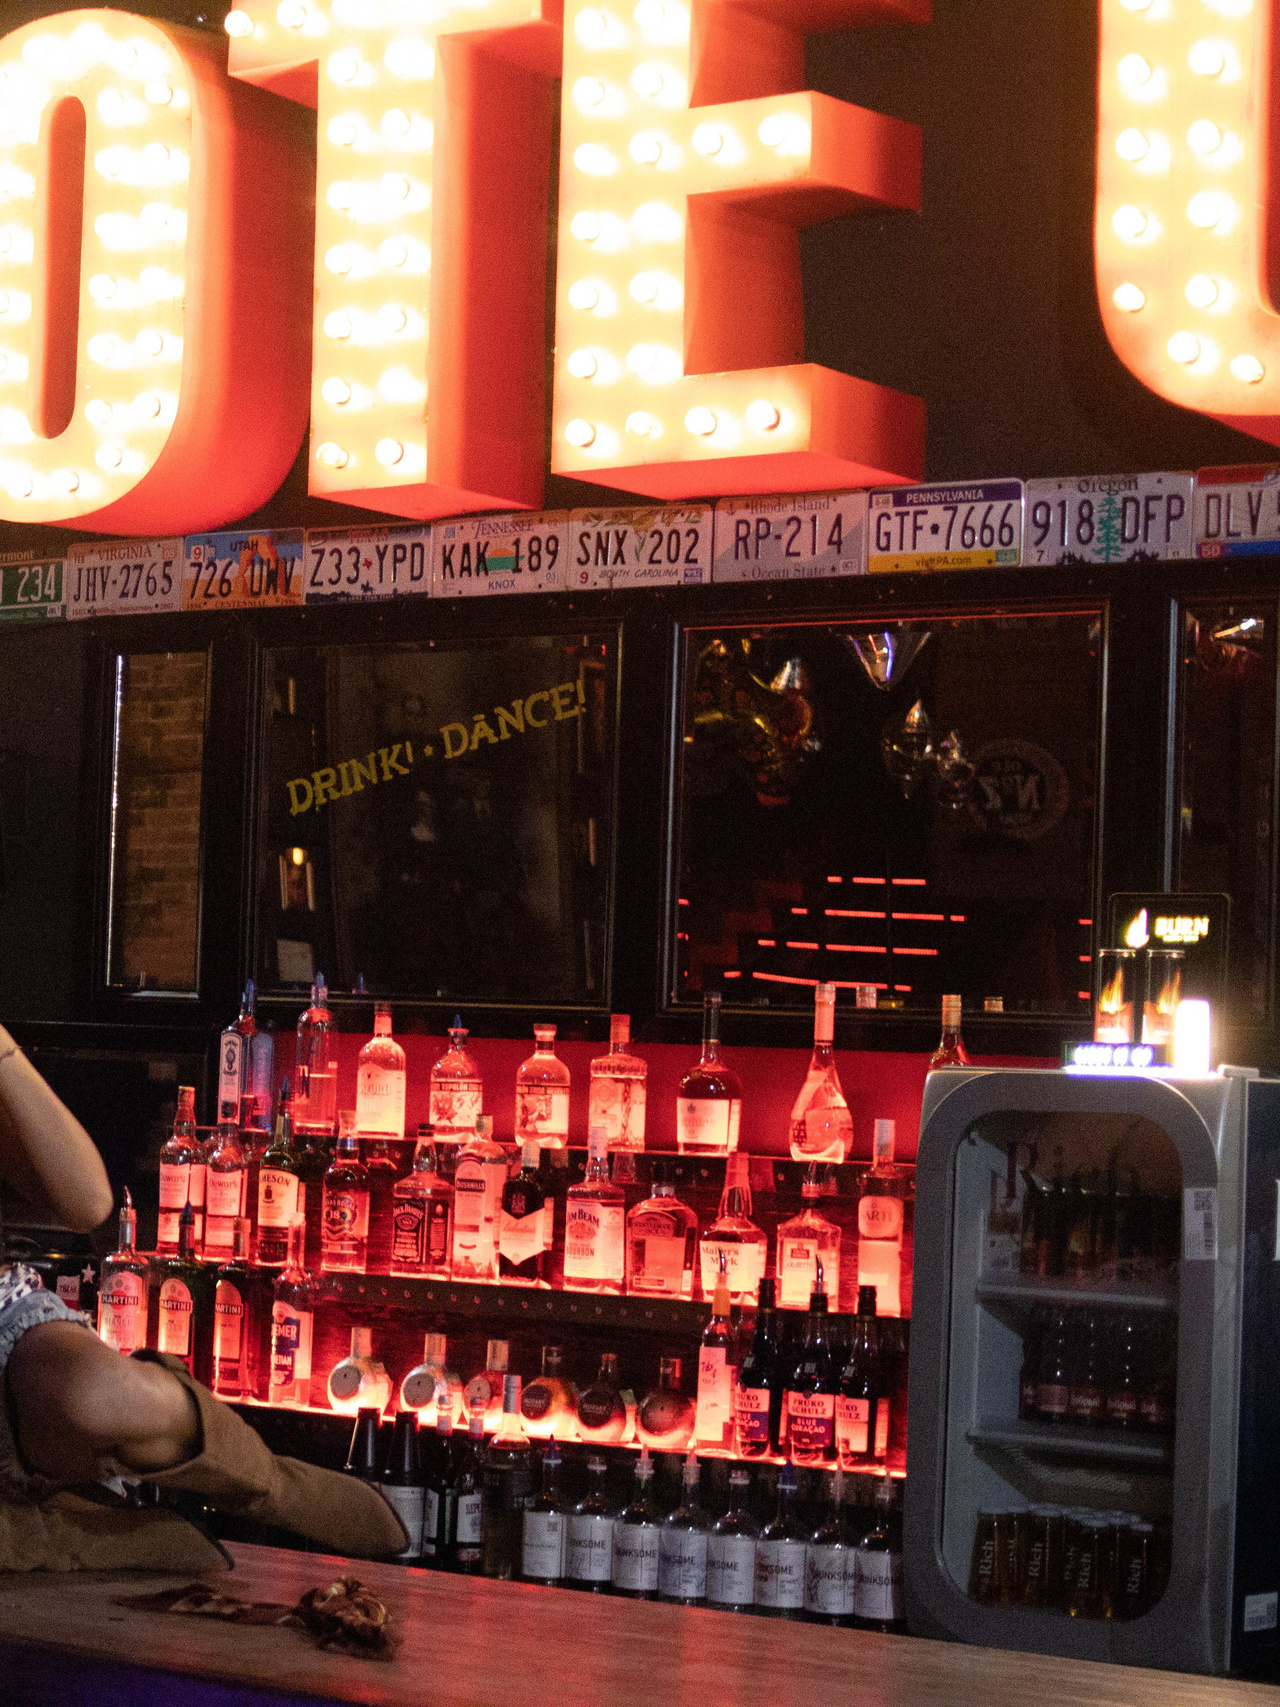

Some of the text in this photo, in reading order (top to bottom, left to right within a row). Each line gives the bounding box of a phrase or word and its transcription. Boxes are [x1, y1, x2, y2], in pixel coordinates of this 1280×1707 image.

[1078, 476, 1138, 495] Oregon
[748, 497, 829, 514] Rhode Island
[906, 489, 984, 504] PENNSYLVANIA
[471, 516, 534, 539] TENNESSEE
[1032, 494, 1185, 547] 918 DFP
[230, 540, 259, 552] UTAH
[734, 512, 843, 560] RP-214
[97, 545, 152, 561] VIRGINIA
[193, 546, 202, 560] 9
[442, 534, 559, 580] KAK 189
[577, 528, 699, 566] SNX 202
[375, 541, 425, 584] YPD
[751, 563, 826, 580] Ocean State
[17, 562, 55, 603] 234
[190, 560, 233, 599] 726
[580, 571, 589, 585] 9
[634, 568, 680, 578] CAROLINA
[488, 578, 516, 591] KNOX
[287, 738, 414, 818] DRINK!
[1154, 917, 1210, 937] BURN
[577, 1207, 601, 1229] BEAM
[101, 1295, 139, 1306] MARTINI
[791, 1406, 827, 1416] SCHULZ
[792, 1397, 825, 1408] FRUKO
[796, 1417, 817, 1426] BLUE
[978, 1539, 996, 1575] Rich
[1028, 1541, 1043, 1577] Rich
[1077, 1552, 1092, 1588] Rich
[1126, 1557, 1142, 1594] Rich
